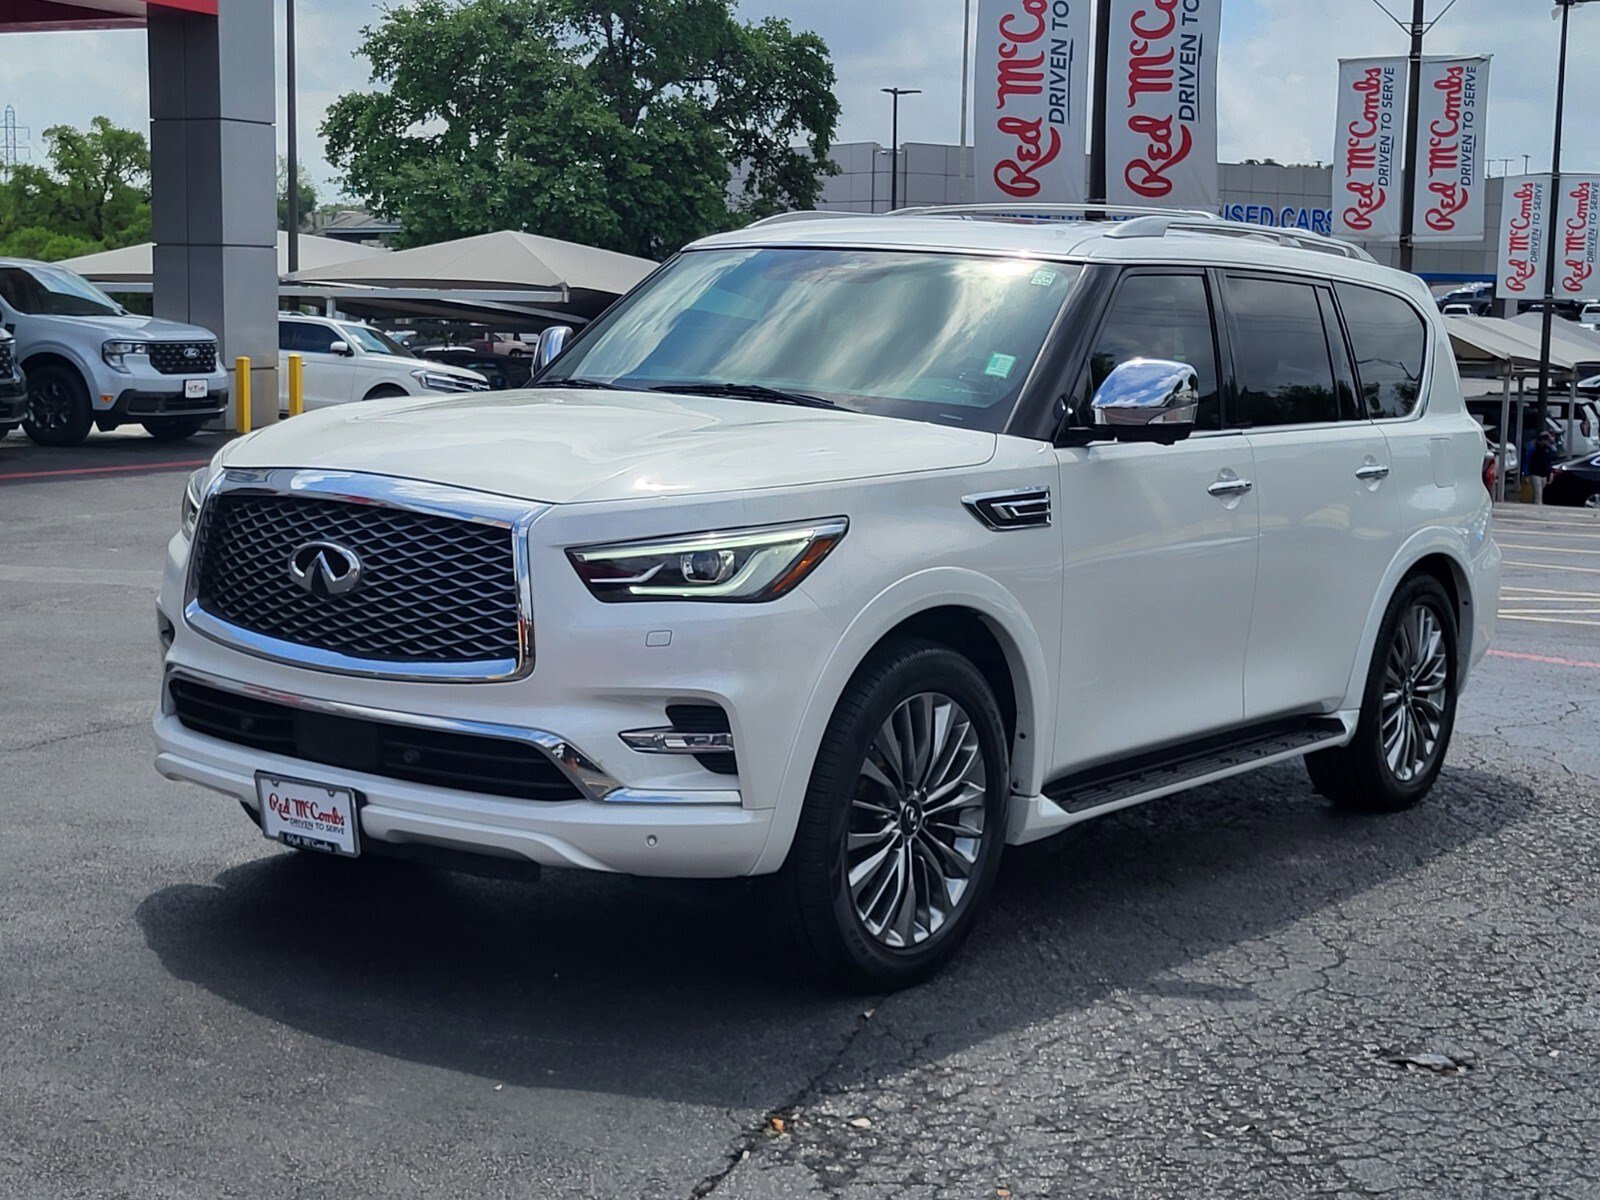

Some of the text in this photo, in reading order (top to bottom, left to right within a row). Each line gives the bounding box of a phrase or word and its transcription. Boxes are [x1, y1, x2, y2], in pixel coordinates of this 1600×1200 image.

[1048, 0, 1070, 124] DRIVEN TO
[1178, 0, 1200, 122] DRIVEN TO
[993, 116, 1061, 198] Red
[1124, 114, 1192, 198] Red
[1343, 67, 1386, 230] Red McCombs
[1378, 66, 1395, 187] DRIVEN TO SERVE
[1425, 65, 1469, 231] Red McCombs
[1460, 66, 1476, 186] DRIVEN TO SERVE
[1505, 182, 1535, 292] Red McCombs
[1530, 182, 1543, 263] DRIVEN TO SERVE
[1562, 182, 1592, 292] Red McCombs
[1586, 181, 1600, 263] DRIVEN TO SERVE
[269, 792, 345, 826] Red McCombs
[290, 817, 345, 835] DRIVEN TO SERVE
